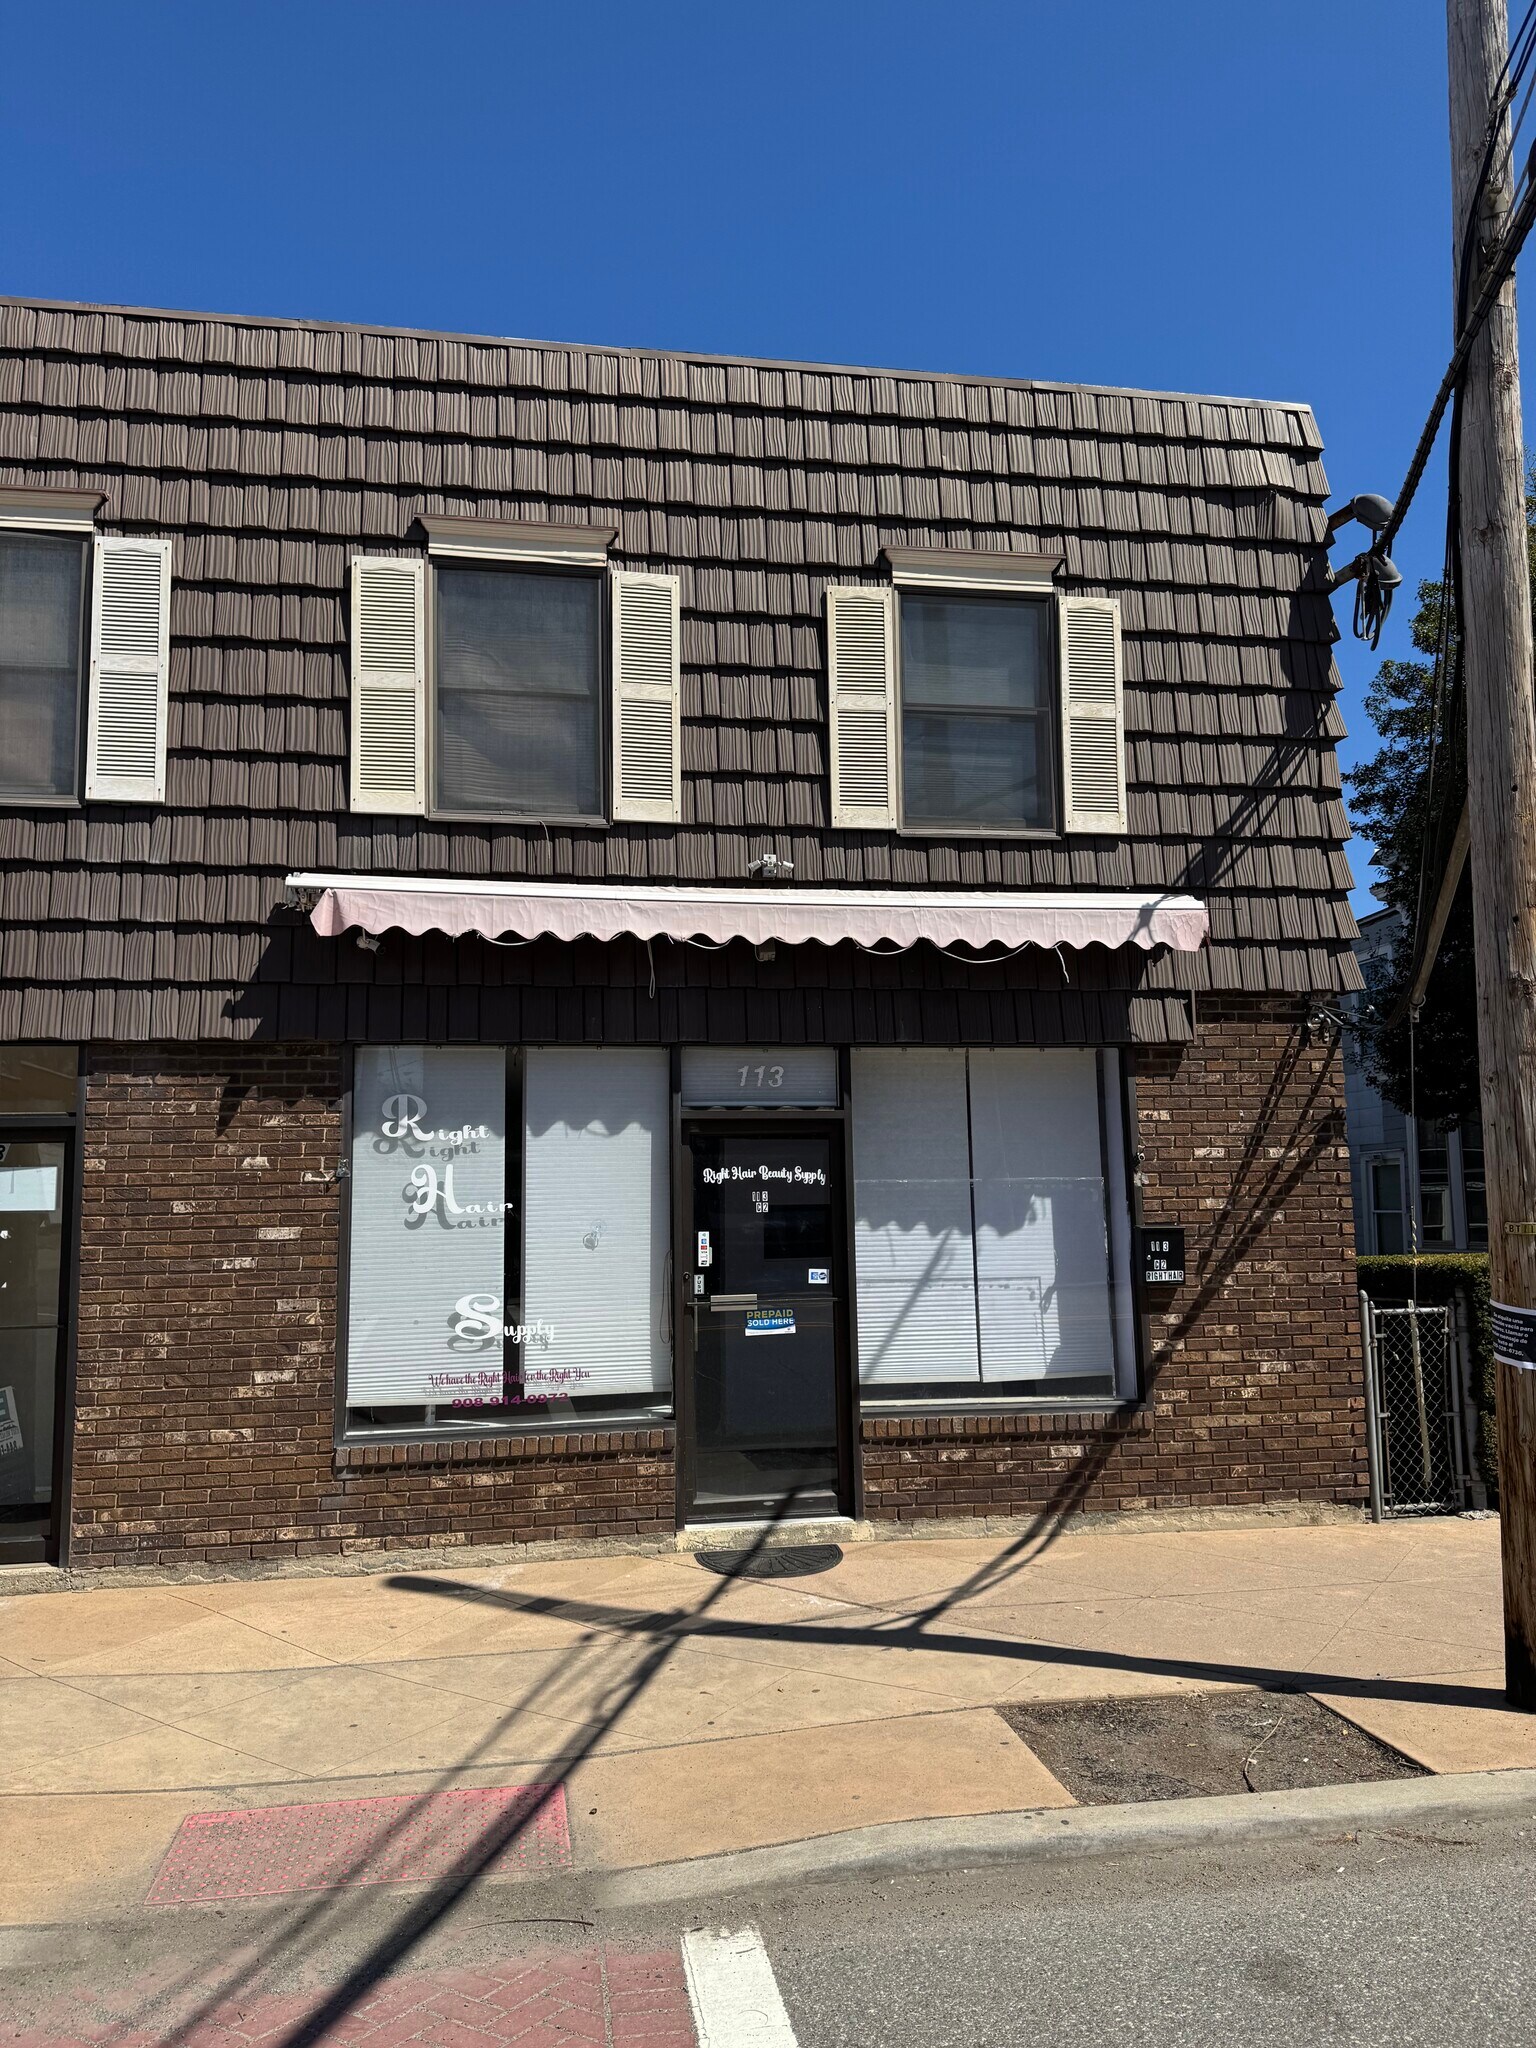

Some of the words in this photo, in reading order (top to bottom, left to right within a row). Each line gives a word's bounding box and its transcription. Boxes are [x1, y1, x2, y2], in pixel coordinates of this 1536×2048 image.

[738, 1065, 784, 1087] 113
[381, 1094, 490, 1145] Right
[703, 1168, 731, 1184] Right
[731, 1166, 757, 1180] Hair
[759, 1165, 793, 1183] Beauty
[794, 1165, 826, 1185] Supply
[411, 1164, 513, 1214] Hair
[1150, 1241, 1169, 1252] 113
[455, 1293, 555, 1344] Supply
[746, 1309, 794, 1319] PREPAID
[771, 1317, 796, 1325] HERE
[465, 1372, 476, 1384] the
[477, 1371, 501, 1387] Right
[549, 1368, 571, 1384] Right
[573, 1367, 591, 1381] You
[452, 1397, 484, 1408] 908
